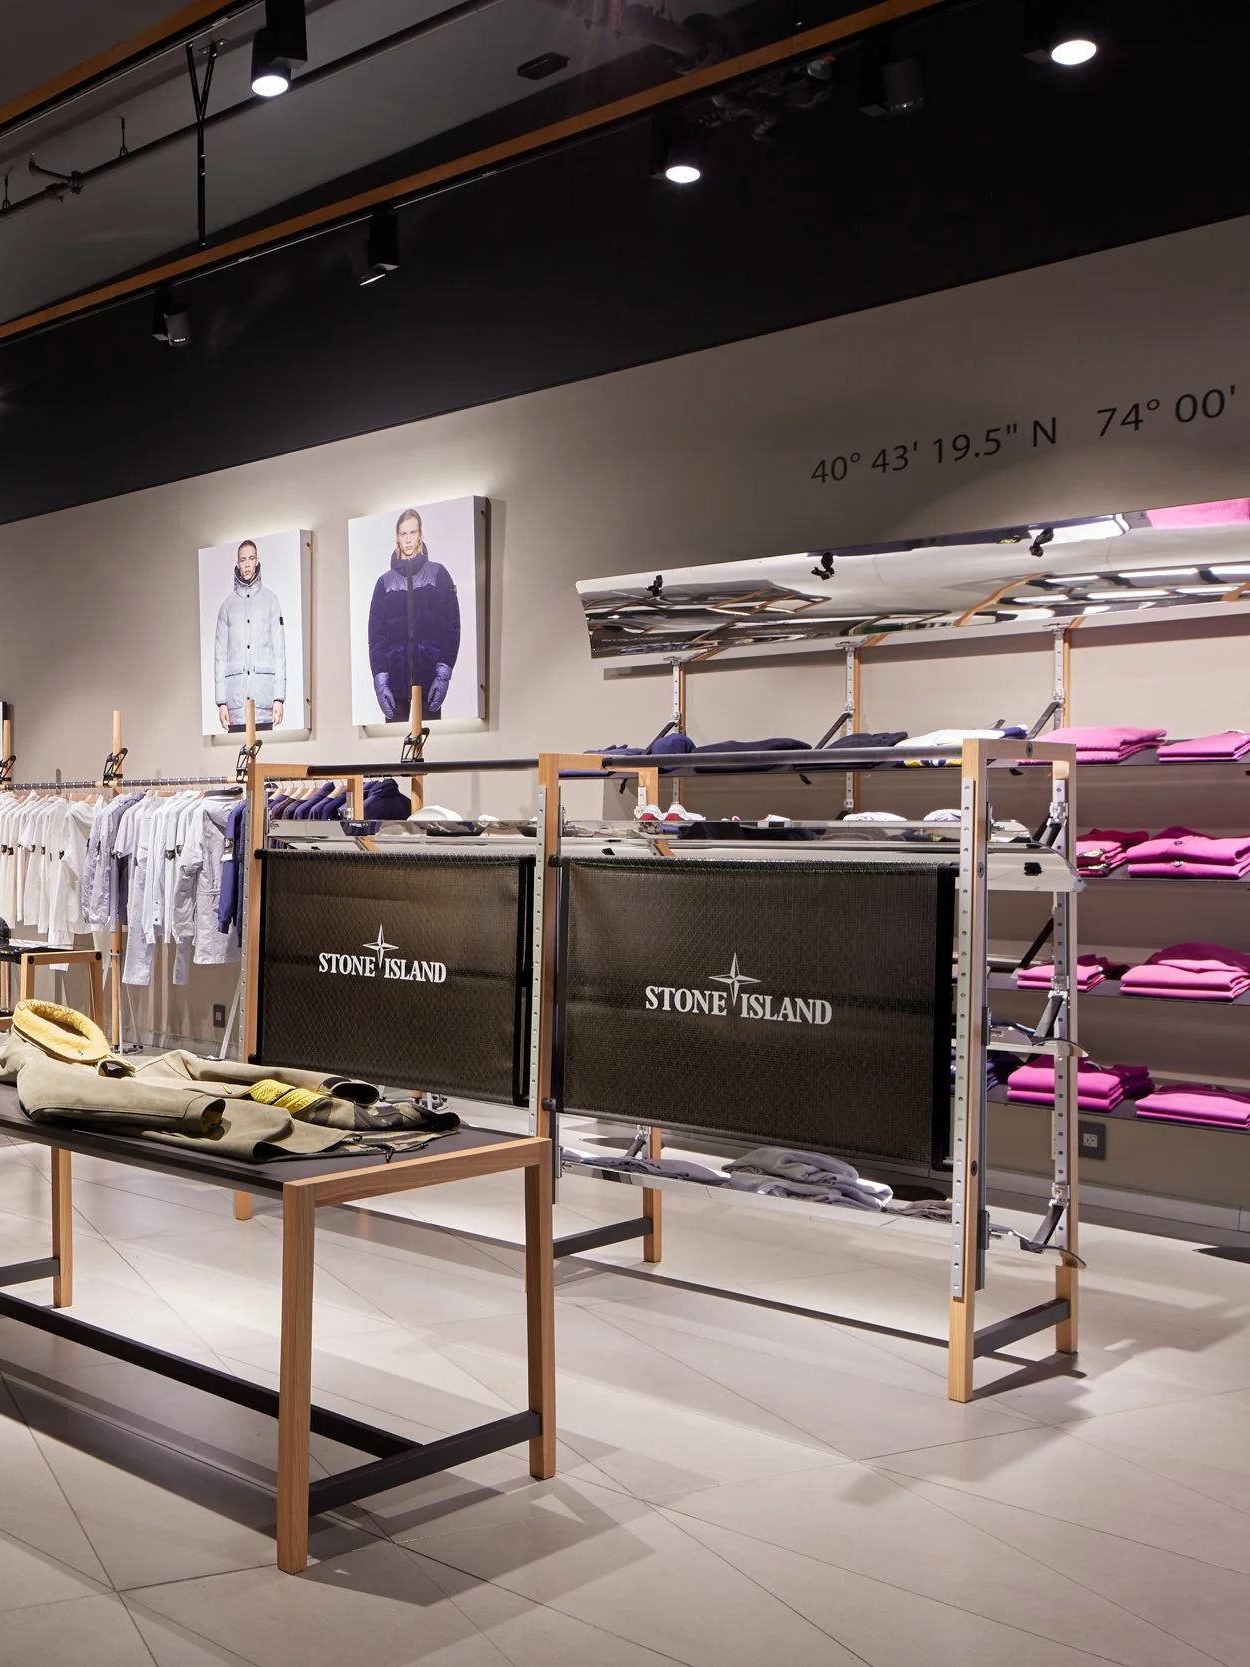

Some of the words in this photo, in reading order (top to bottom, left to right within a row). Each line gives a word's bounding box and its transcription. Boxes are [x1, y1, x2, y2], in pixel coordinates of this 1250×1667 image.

[810, 451, 861, 484] 40°
[870, 441, 918, 474] 43'
[1032, 416, 1057, 448] N
[1096, 398, 1161, 438] 74°
[1174, 384, 1236, 423] 00'
[318, 952, 376, 977] STONE
[383, 957, 447, 984] ISLAND
[645, 985, 728, 1016] STONE
[739, 993, 833, 1025] ISLAND
